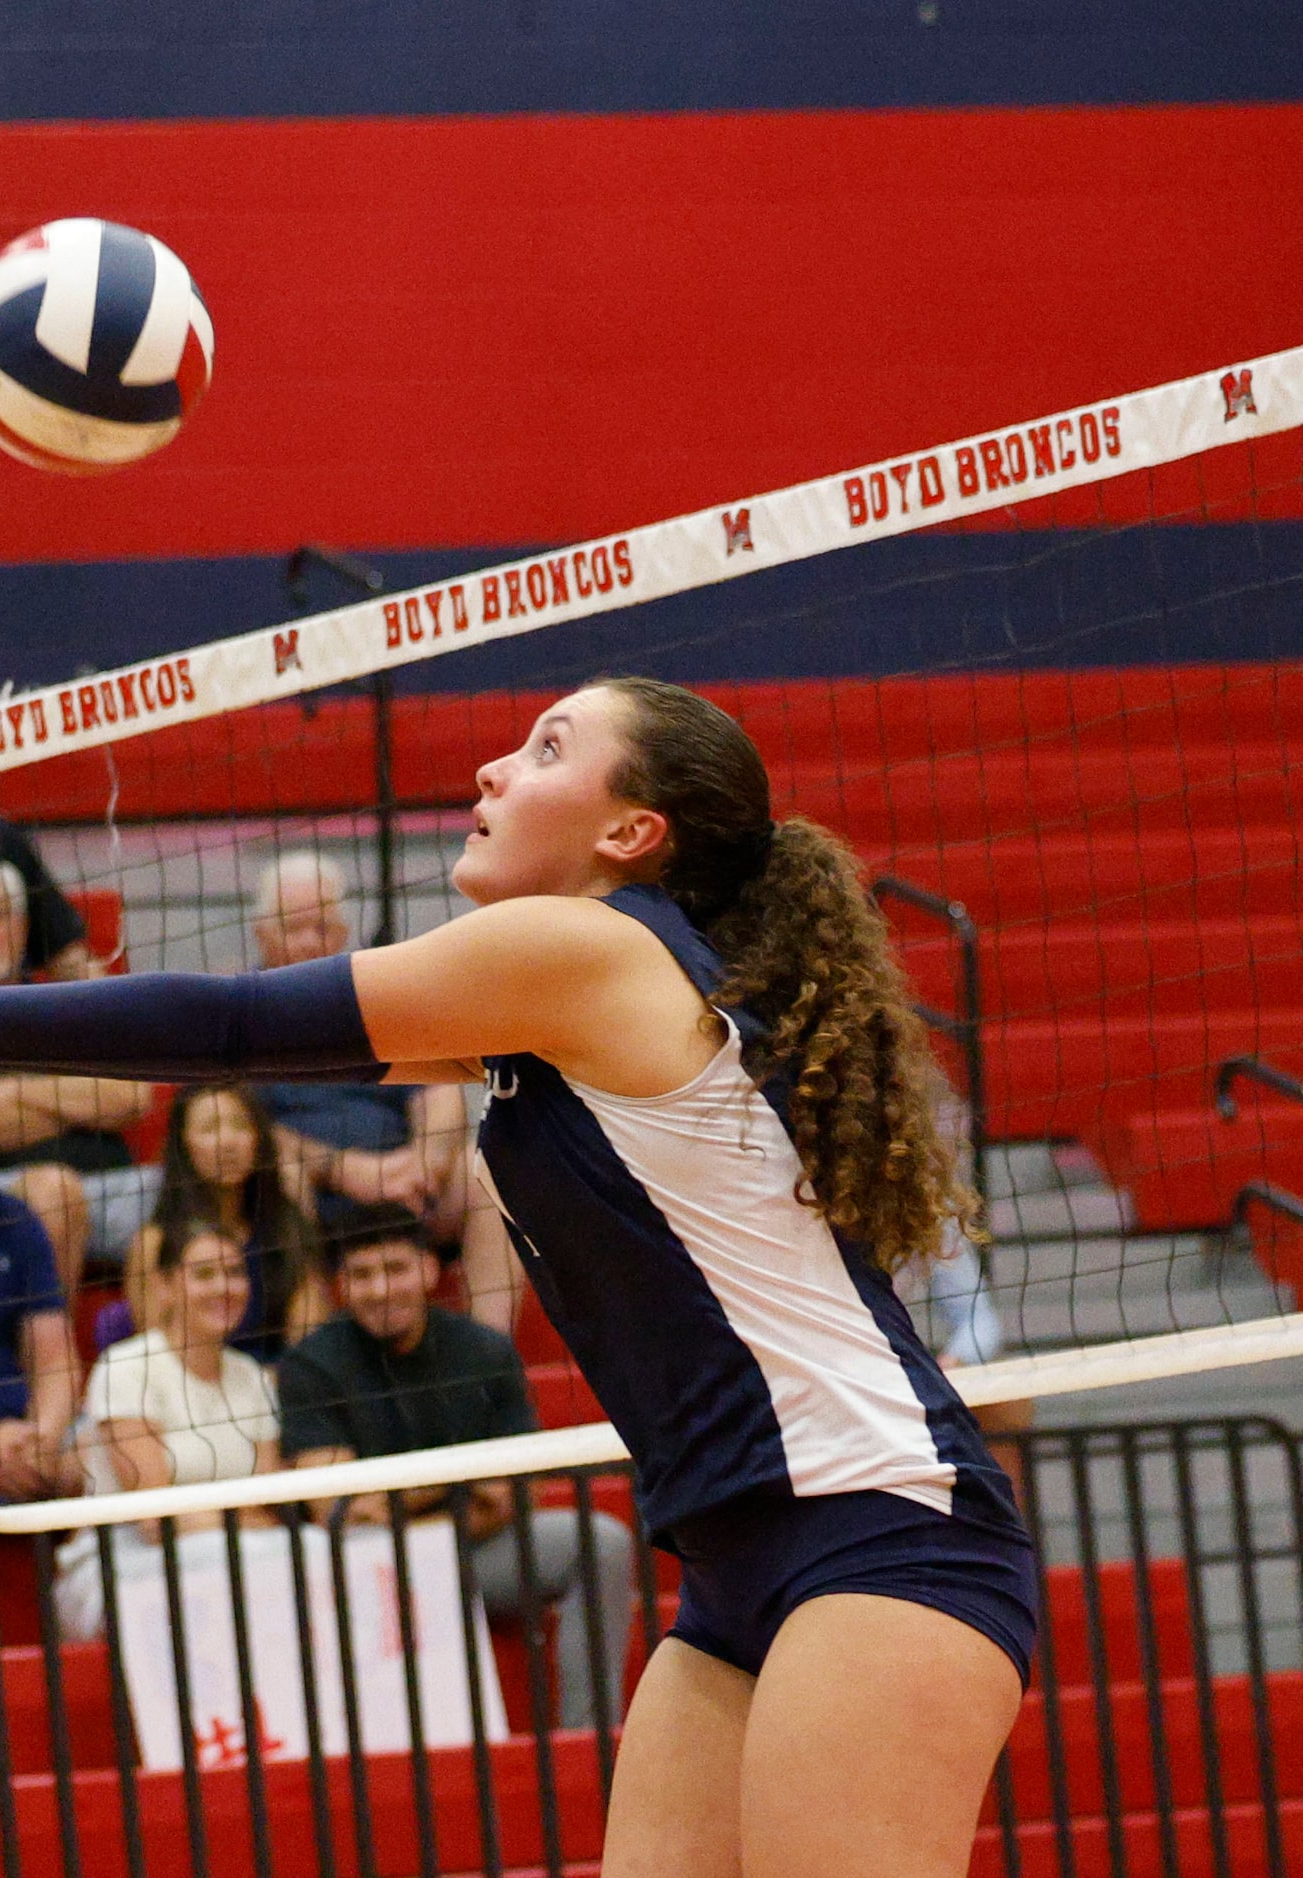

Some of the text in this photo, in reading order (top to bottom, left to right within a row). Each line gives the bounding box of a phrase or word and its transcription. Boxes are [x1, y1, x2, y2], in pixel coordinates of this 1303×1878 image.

[844, 406, 1121, 527] BOYD BRONCOS
[383, 539, 634, 649] BOYD BRONCOS
[58, 658, 196, 735] BRONCOS
